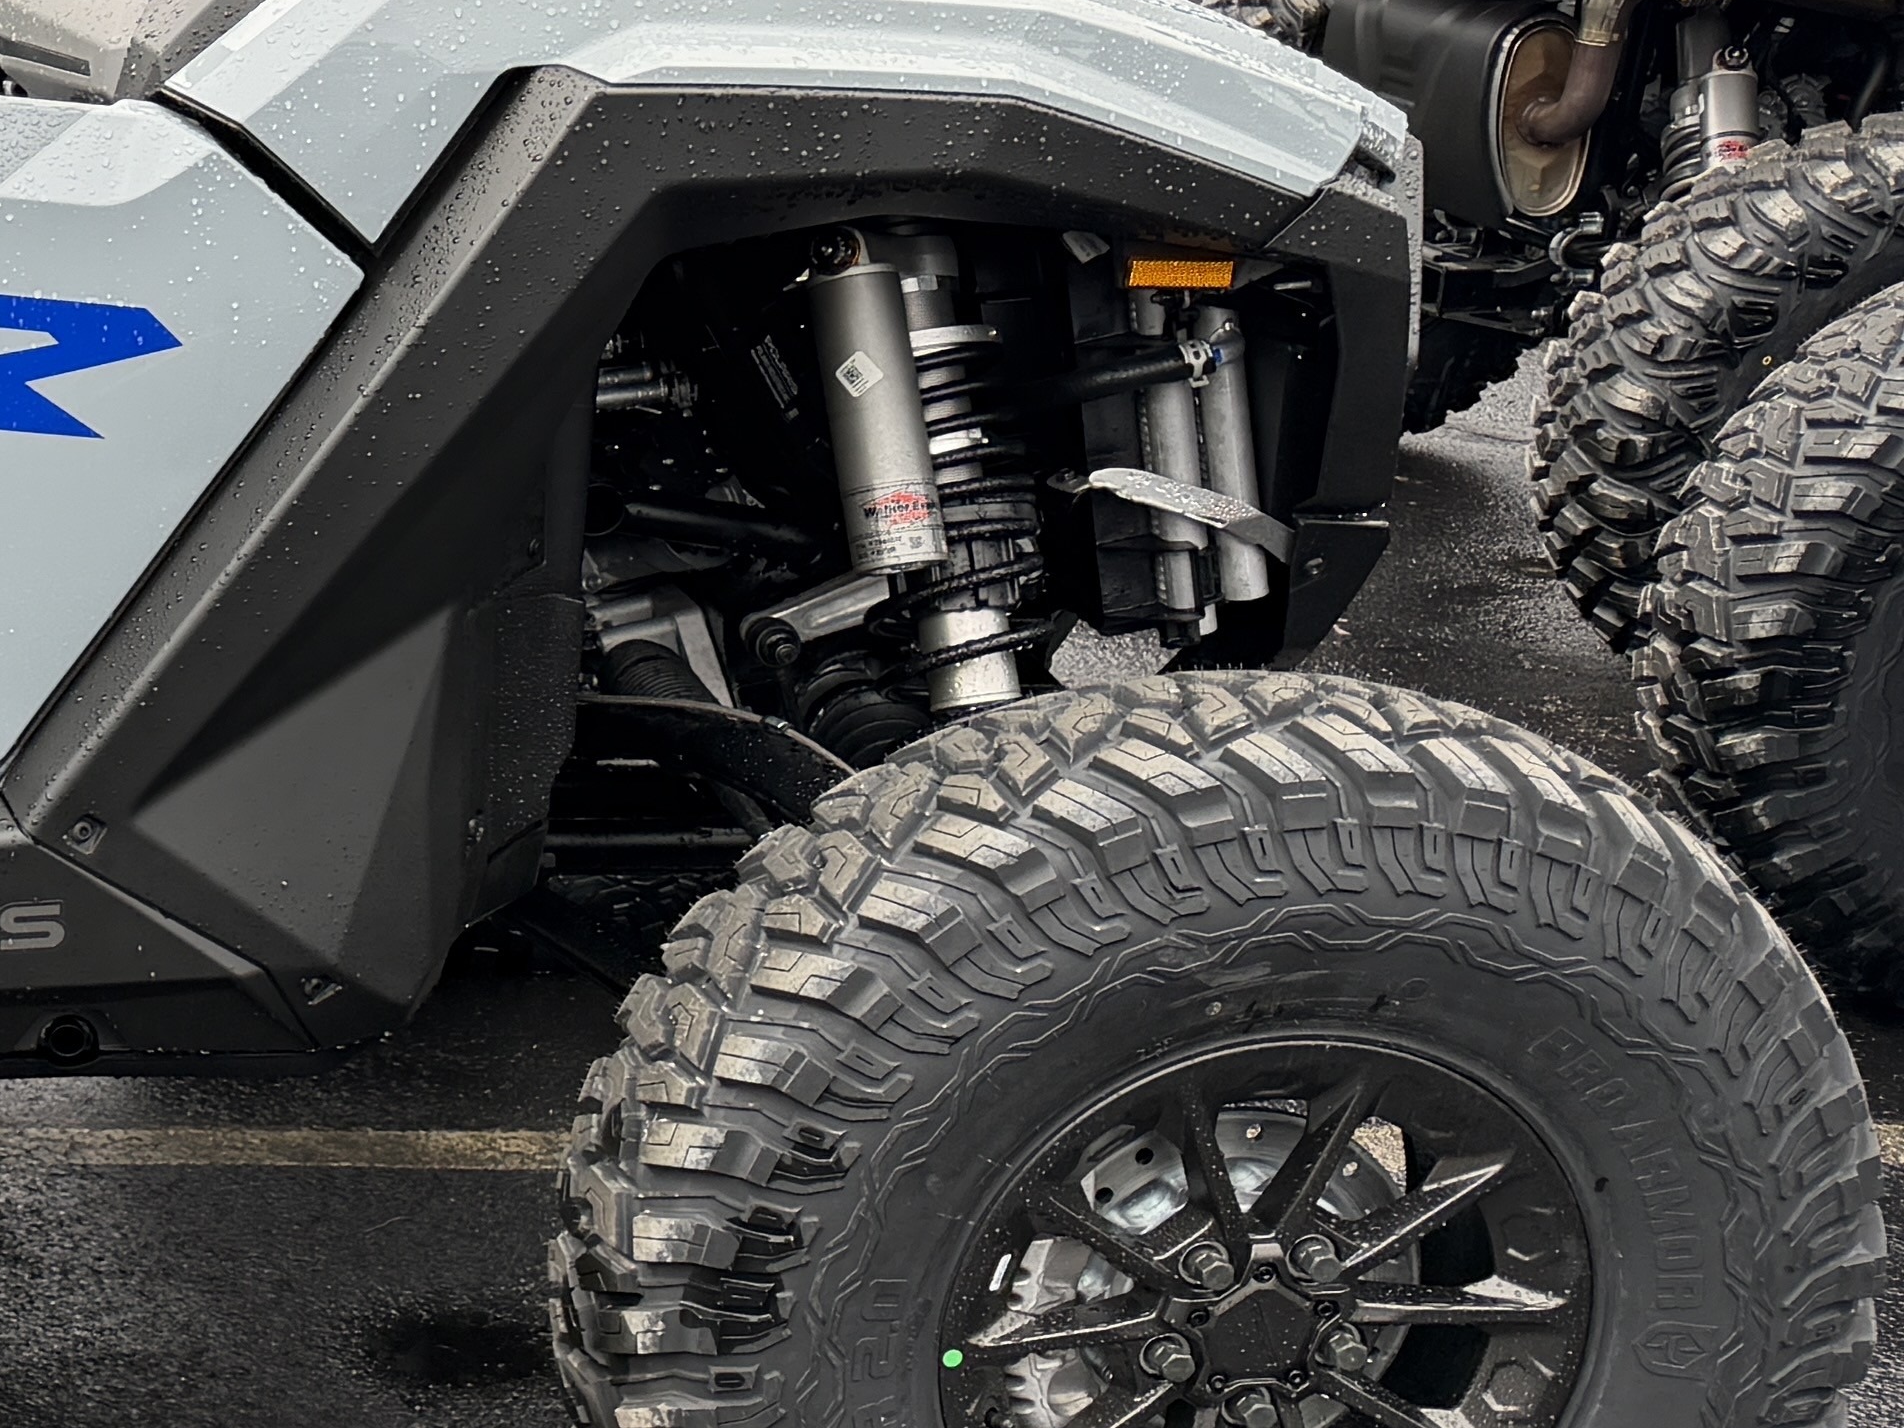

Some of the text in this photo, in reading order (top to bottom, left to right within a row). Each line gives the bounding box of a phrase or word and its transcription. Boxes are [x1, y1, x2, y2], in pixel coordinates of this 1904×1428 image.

[1527, 1025, 1706, 1310] PRO ARMOR
[852, 1278, 910, 1383] 2.0
